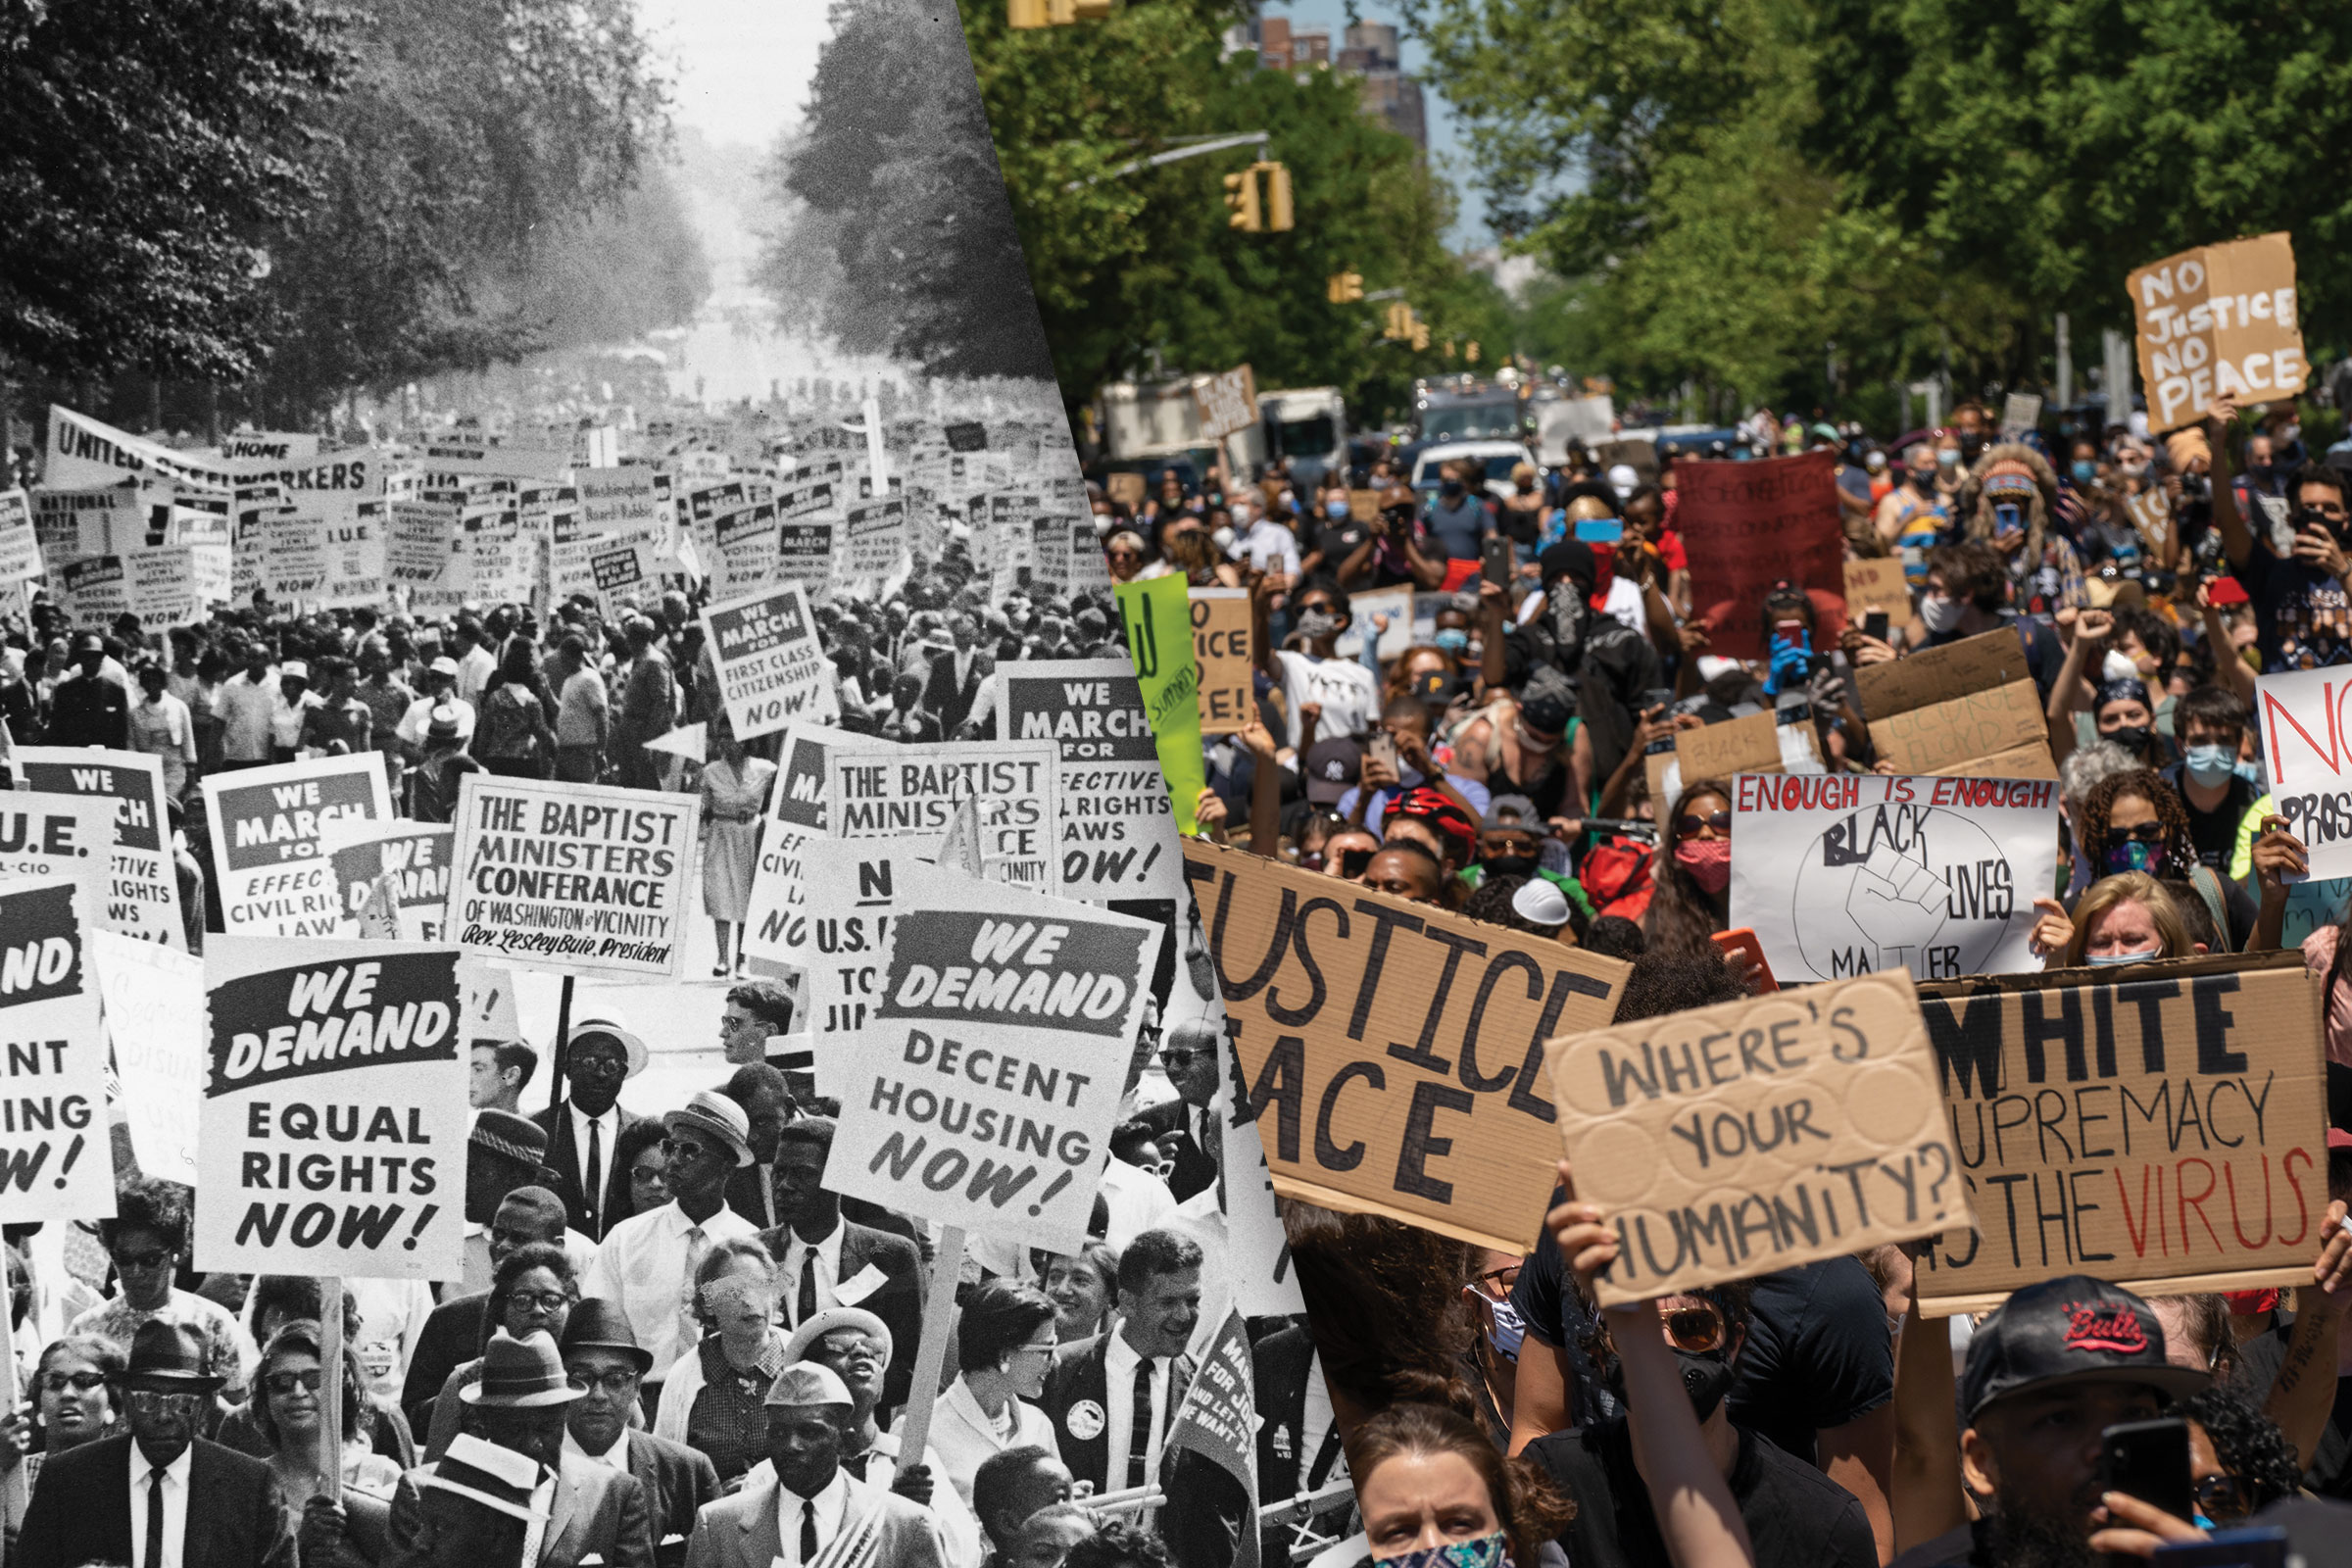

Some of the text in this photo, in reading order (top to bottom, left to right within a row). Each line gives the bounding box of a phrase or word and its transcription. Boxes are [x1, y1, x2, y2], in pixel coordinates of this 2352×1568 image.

[2140, 260, 2205, 308] NO
[2151, 335, 2209, 382] NO
[2156, 348, 2302, 425] PEACE
[721, 610, 799, 649] MARCH
[740, 603, 769, 622] WE
[725, 644, 814, 683] FIRST CLASS
[748, 635, 778, 652] FOR
[1193, 629, 1250, 663] ICE,
[726, 661, 821, 701] CITIZENSHIP
[1062, 682, 1110, 707] WE
[746, 683, 819, 727] NOW!
[1021, 709, 1153, 739] MARCH
[1062, 743, 1115, 758] FOR
[1906, 719, 2002, 772] FLOYD
[2262, 679, 2352, 785] N
[71, 768, 115, 793] WE
[271, 782, 321, 810] WE
[840, 765, 888, 799] THE
[901, 760, 1041, 797] BAPTIST
[1737, 774, 2054, 812] ENOUGH IS ENOUGH
[478, 795, 678, 845] THE BAPTIST
[1077, 795, 1171, 815] RIGHTS
[380, 836, 435, 870] WE
[1062, 821, 1126, 842] AWS
[1823, 802, 1932, 870] BLACK
[467, 834, 676, 880] MINISTERS
[1000, 860, 1047, 883] CINITY
[1062, 841, 1162, 884] OW!
[110, 878, 171, 904] IGHTS
[476, 865, 666, 909] CONFERANCE
[1945, 858, 2014, 920] LIVES
[229, 897, 297, 924] CIVIL
[465, 898, 487, 923] OF
[489, 900, 585, 932] WASHINGTON
[593, 907, 669, 939] VICINITY
[461, 923, 497, 946] Rev.
[598, 937, 673, 965] President
[816, 916, 871, 954] U.S.
[970, 917, 1070, 965] WE
[288, 961, 382, 1018] WE
[895, 963, 1127, 1020] DEMAND
[1183, 858, 1613, 1125] USTICE
[222, 1001, 452, 1080] DEMAND
[1597, 999, 1869, 1108] WHERE'S
[1918, 972, 2249, 1101] WHITE
[903, 1027, 1092, 1109] DECENT
[247, 1101, 431, 1146] EQUAL
[868, 1075, 1093, 1168] HOUSING
[1251, 1034, 1476, 1205] ACE
[1670, 1098, 1833, 1169] YOUR
[1952, 1069, 2274, 1169] UPREMACY
[241, 1151, 437, 1197] RIGHTS
[867, 1130, 1074, 1218] NOW!
[234, 1201, 441, 1251] NOW!
[1985, 1169, 2117, 1269] THE
[2113, 1146, 2314, 1259] VIRUS
[2062, 1304, 2146, 1345] Bulls
[1204, 1359, 1237, 1393] FOR
[1196, 1410, 1237, 1443] WANT
[1211, 1399, 1237, 1423] LET
